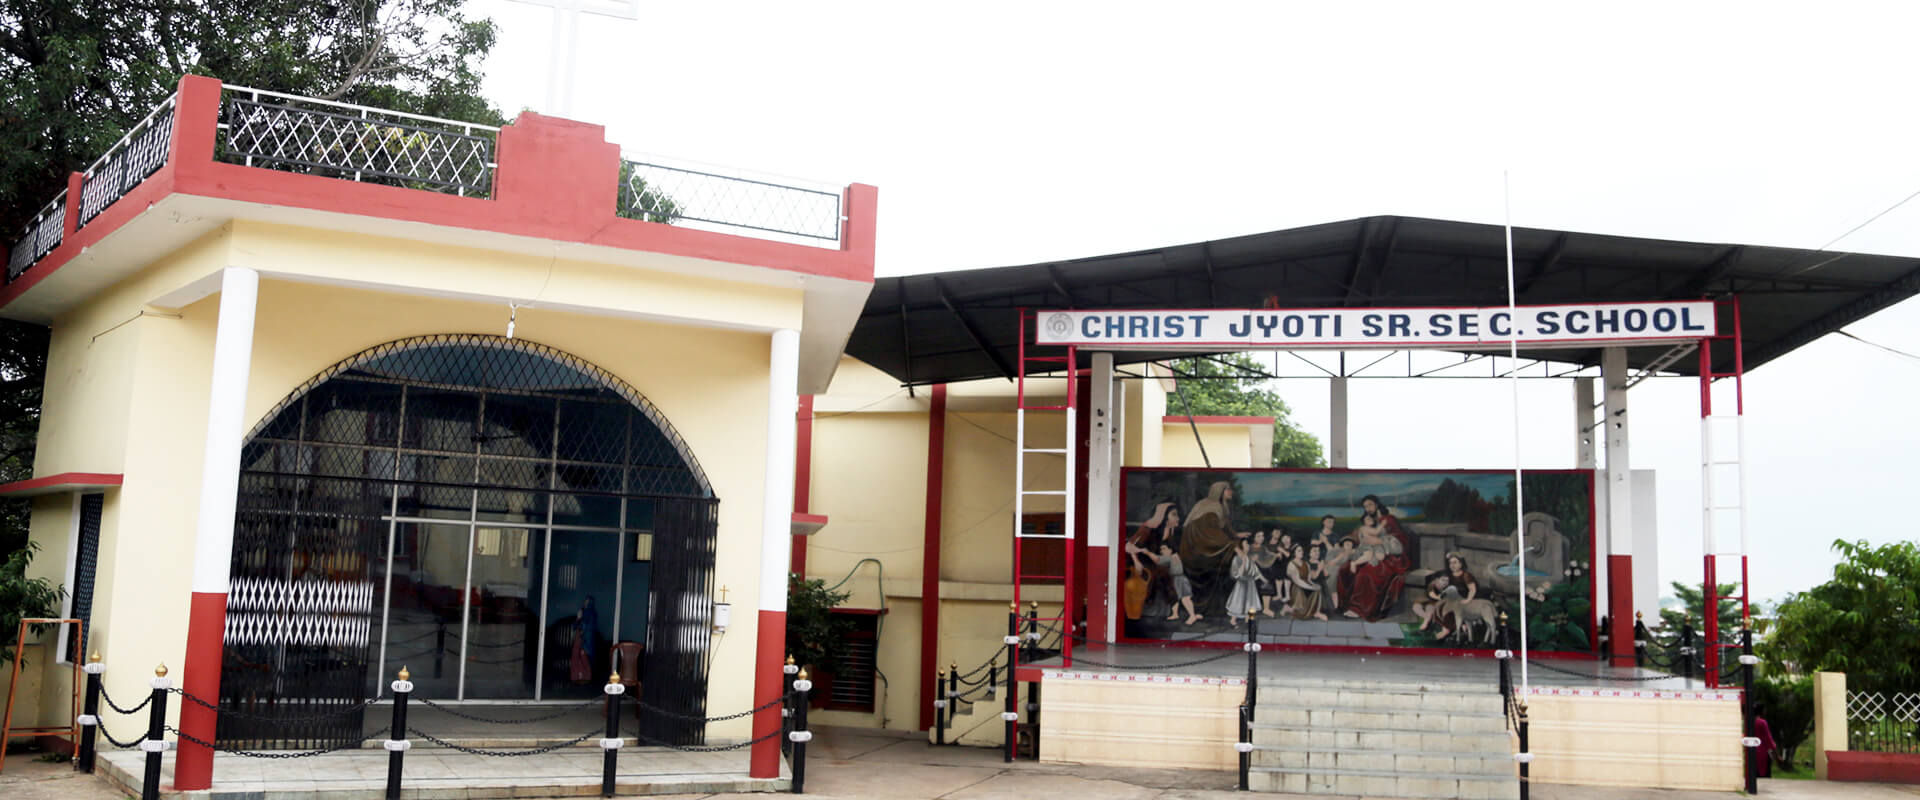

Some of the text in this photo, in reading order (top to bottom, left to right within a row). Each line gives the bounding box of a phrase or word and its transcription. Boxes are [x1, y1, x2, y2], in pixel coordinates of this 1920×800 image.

[1081, 315, 1209, 338] CHRIST
[1229, 314, 1342, 338] JYOTI
[1536, 307, 1705, 335] SCHOOL
